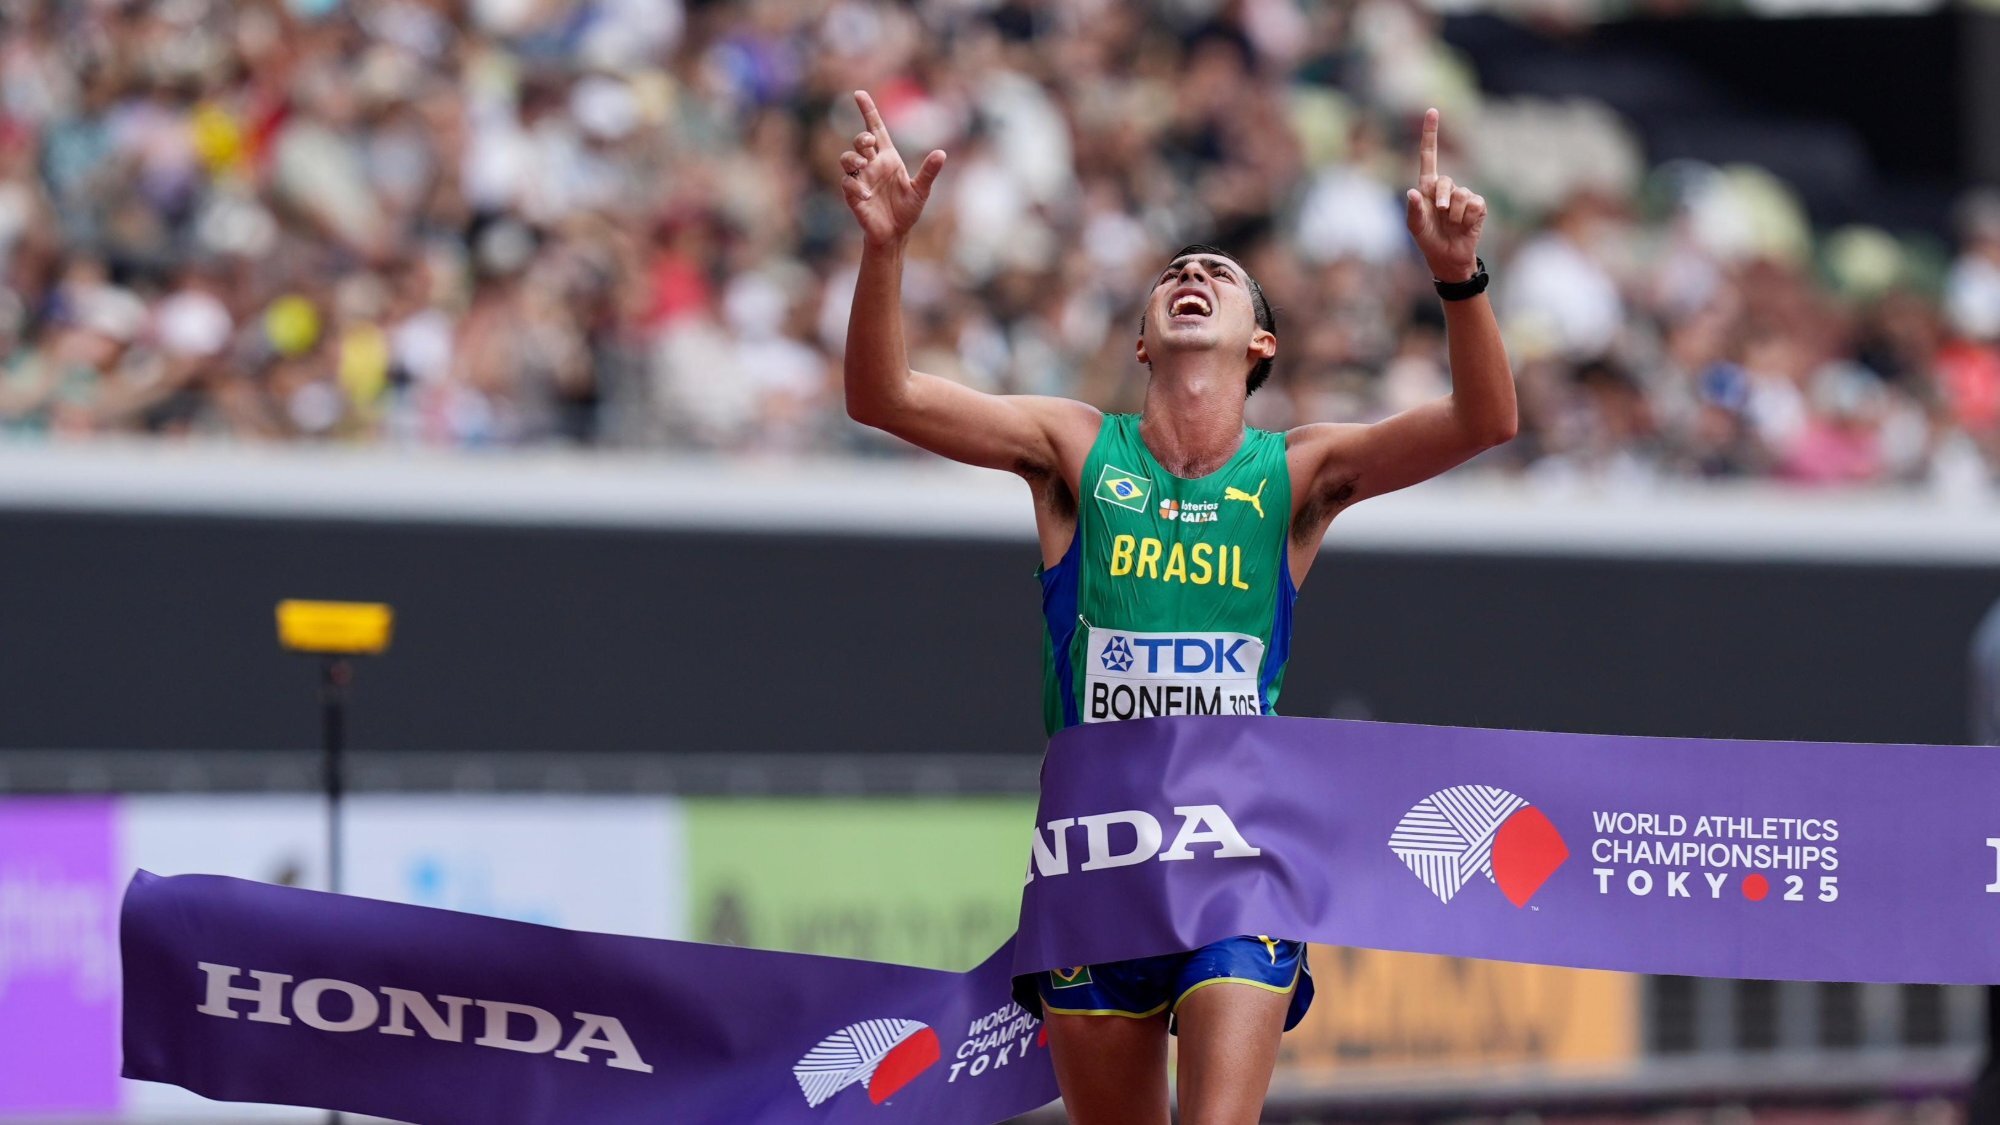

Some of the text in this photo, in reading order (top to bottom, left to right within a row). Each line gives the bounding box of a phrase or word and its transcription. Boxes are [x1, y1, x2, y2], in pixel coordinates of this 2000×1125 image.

[1180, 511, 1218, 522] CAIXA
[1110, 534, 1249, 590] BRASIL
[1133, 638, 1250, 673] TDK
[1092, 682, 1221, 720] BONFIM
[1592, 810, 1839, 842] WORLD ATHLETICS
[1024, 804, 1261, 887] NDA
[1591, 838, 1839, 871] CHAMPIONSHIPS
[196, 961, 654, 1074] HONDA
[956, 1012, 1040, 1060] CHAMPIO
[968, 1001, 1022, 1037] WORLD
